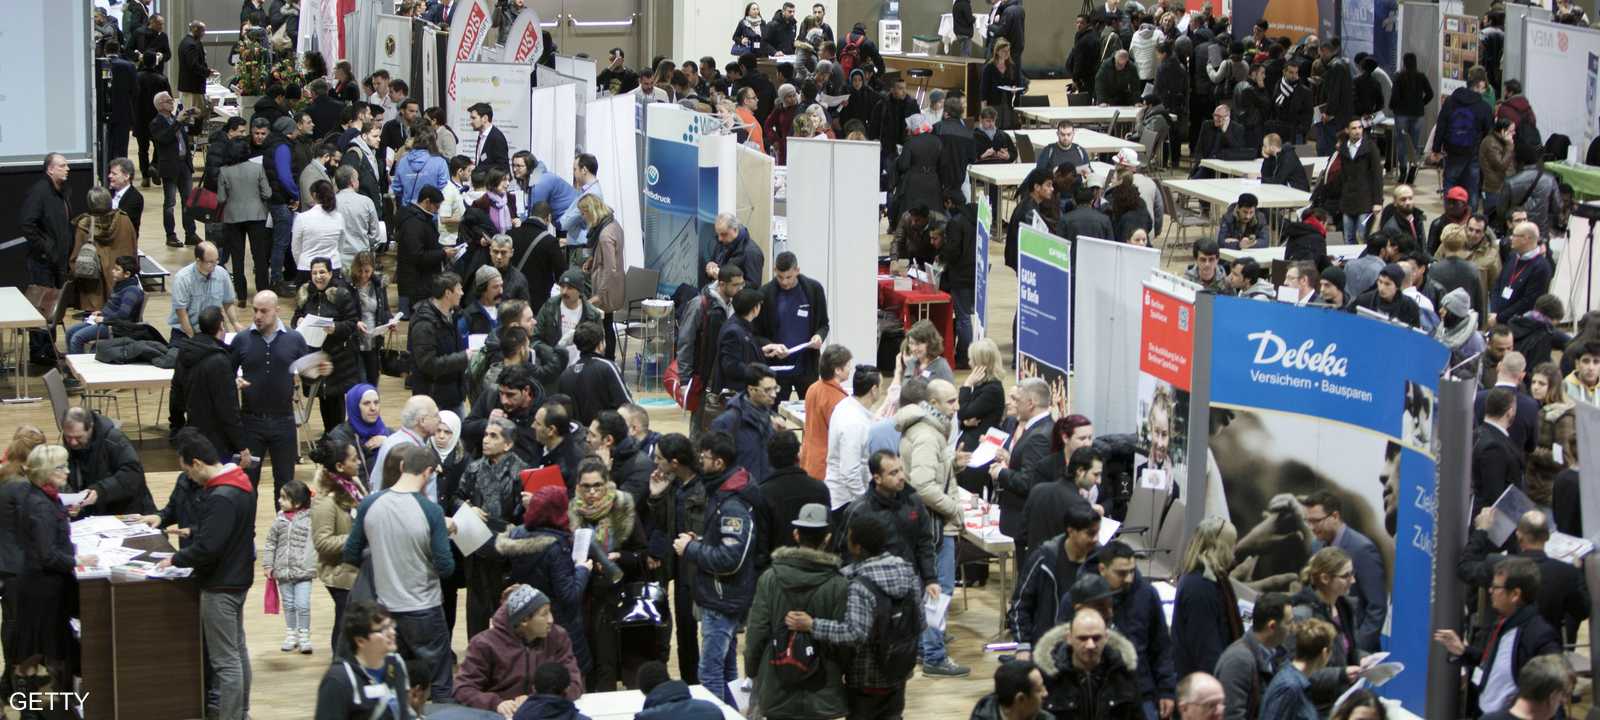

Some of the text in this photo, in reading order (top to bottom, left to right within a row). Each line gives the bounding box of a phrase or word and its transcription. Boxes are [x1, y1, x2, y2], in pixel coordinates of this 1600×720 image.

[1248, 330, 1348, 377] Debeka
[1251, 369, 1372, 402] Versichern Bausparen
